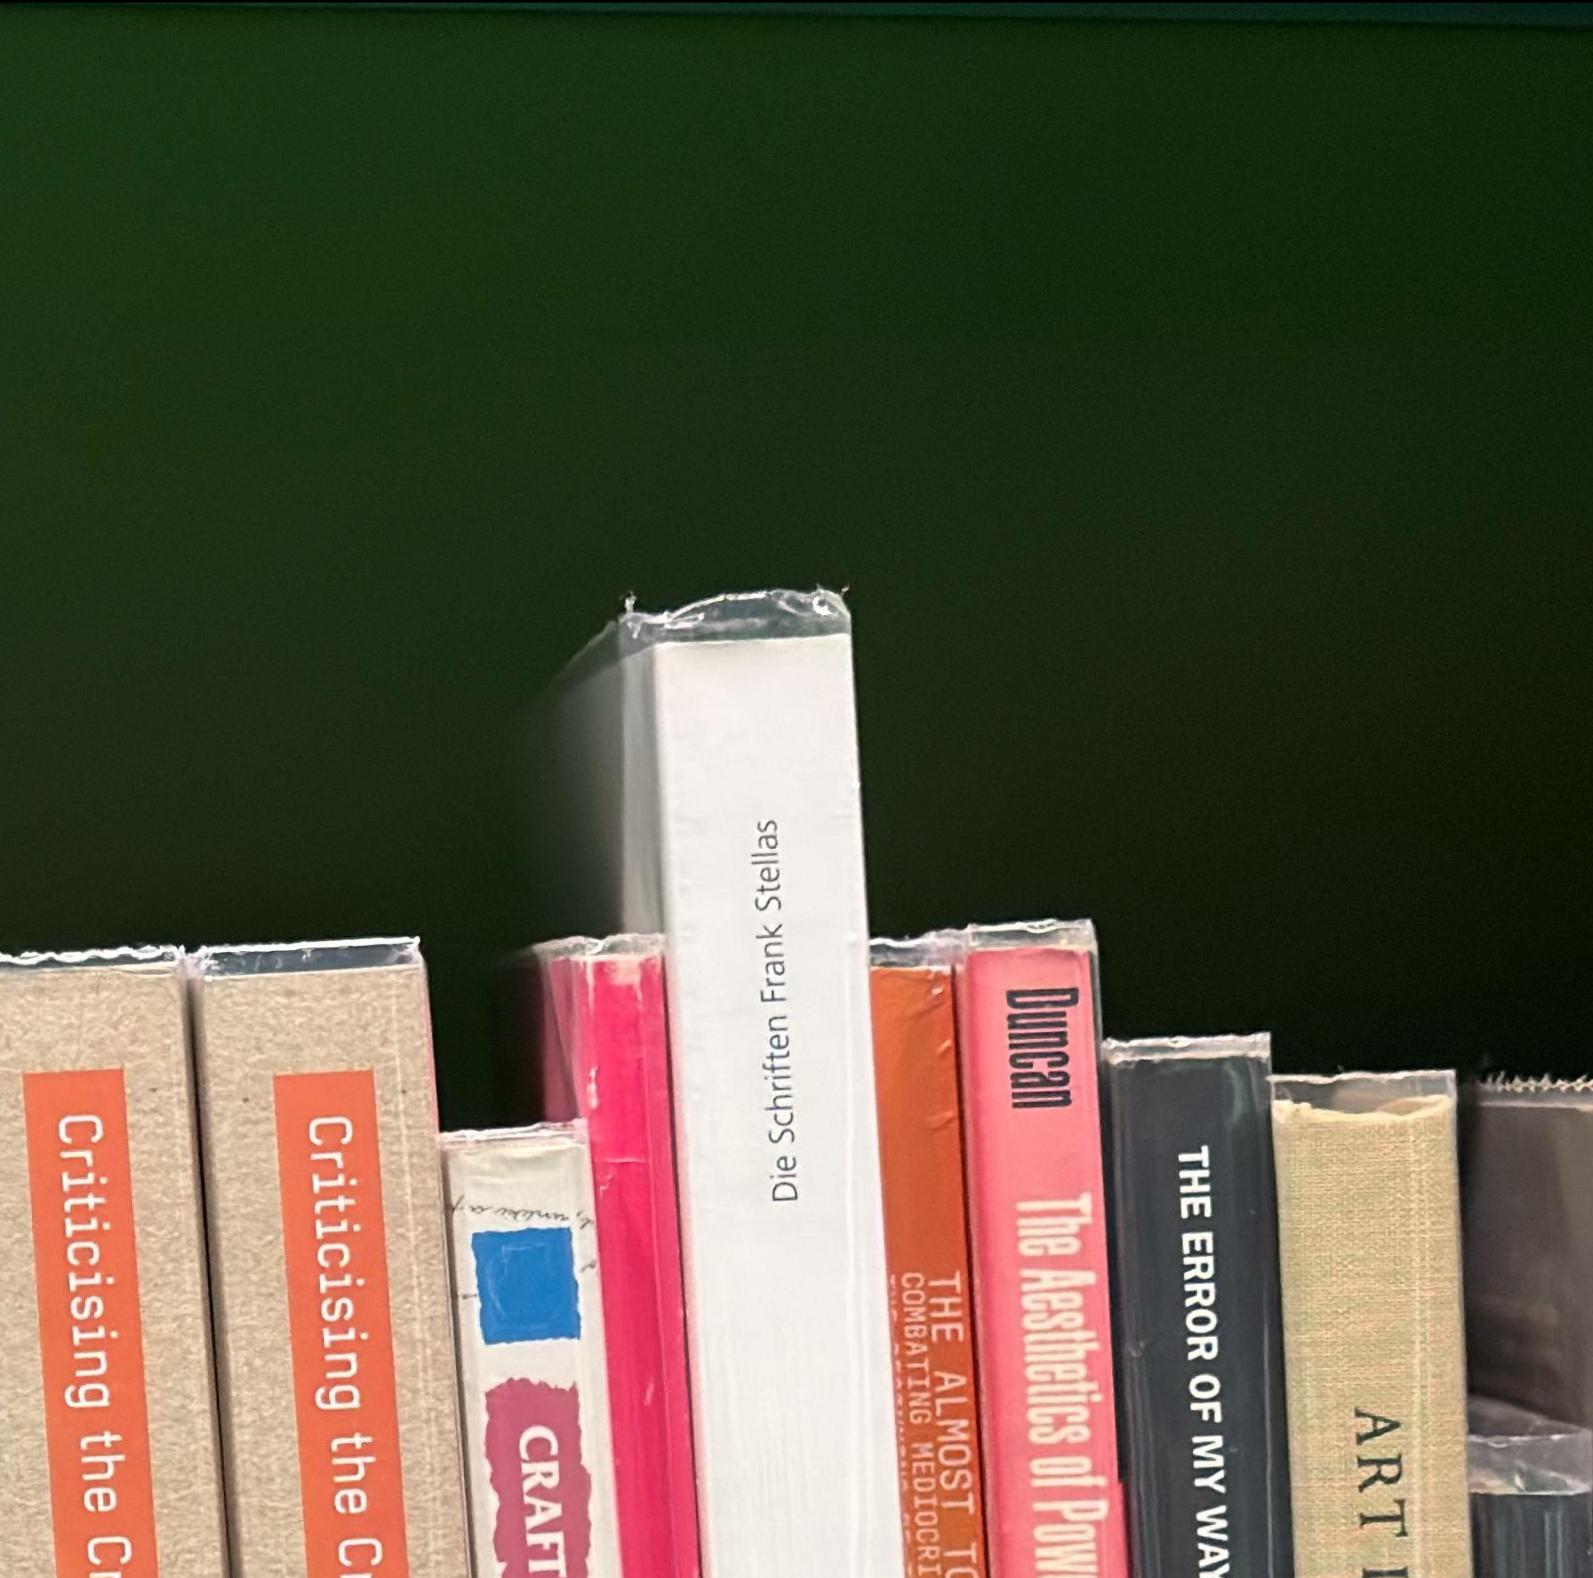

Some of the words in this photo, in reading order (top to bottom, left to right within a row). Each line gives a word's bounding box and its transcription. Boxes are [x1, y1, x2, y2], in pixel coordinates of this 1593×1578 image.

[751, 818, 783, 916] Stellas
[756, 921, 789, 1012] Frank
[762, 1014, 796, 1144] Schriften
[1005, 986, 1078, 1111] Duncan
[771, 1151, 798, 1201] Die
[1177, 1145, 1212, 1220] THE
[57, 1113, 111, 1409] Criticising
[1016, 1192, 1093, 1258] The
[928, 1271, 964, 1342] THE
[1181, 1231, 1218, 1362] ERROR
[1020, 1270, 1102, 1444] Aesthetics
[1187, 1373, 1223, 1422] OF
[79, 1426, 126, 1513] the
[934, 1372, 974, 1513] ALMOST
[1028, 1456, 1104, 1489] of
[1190, 1433, 1227, 1494] MY
[1355, 1407, 1403, 1538] ART
